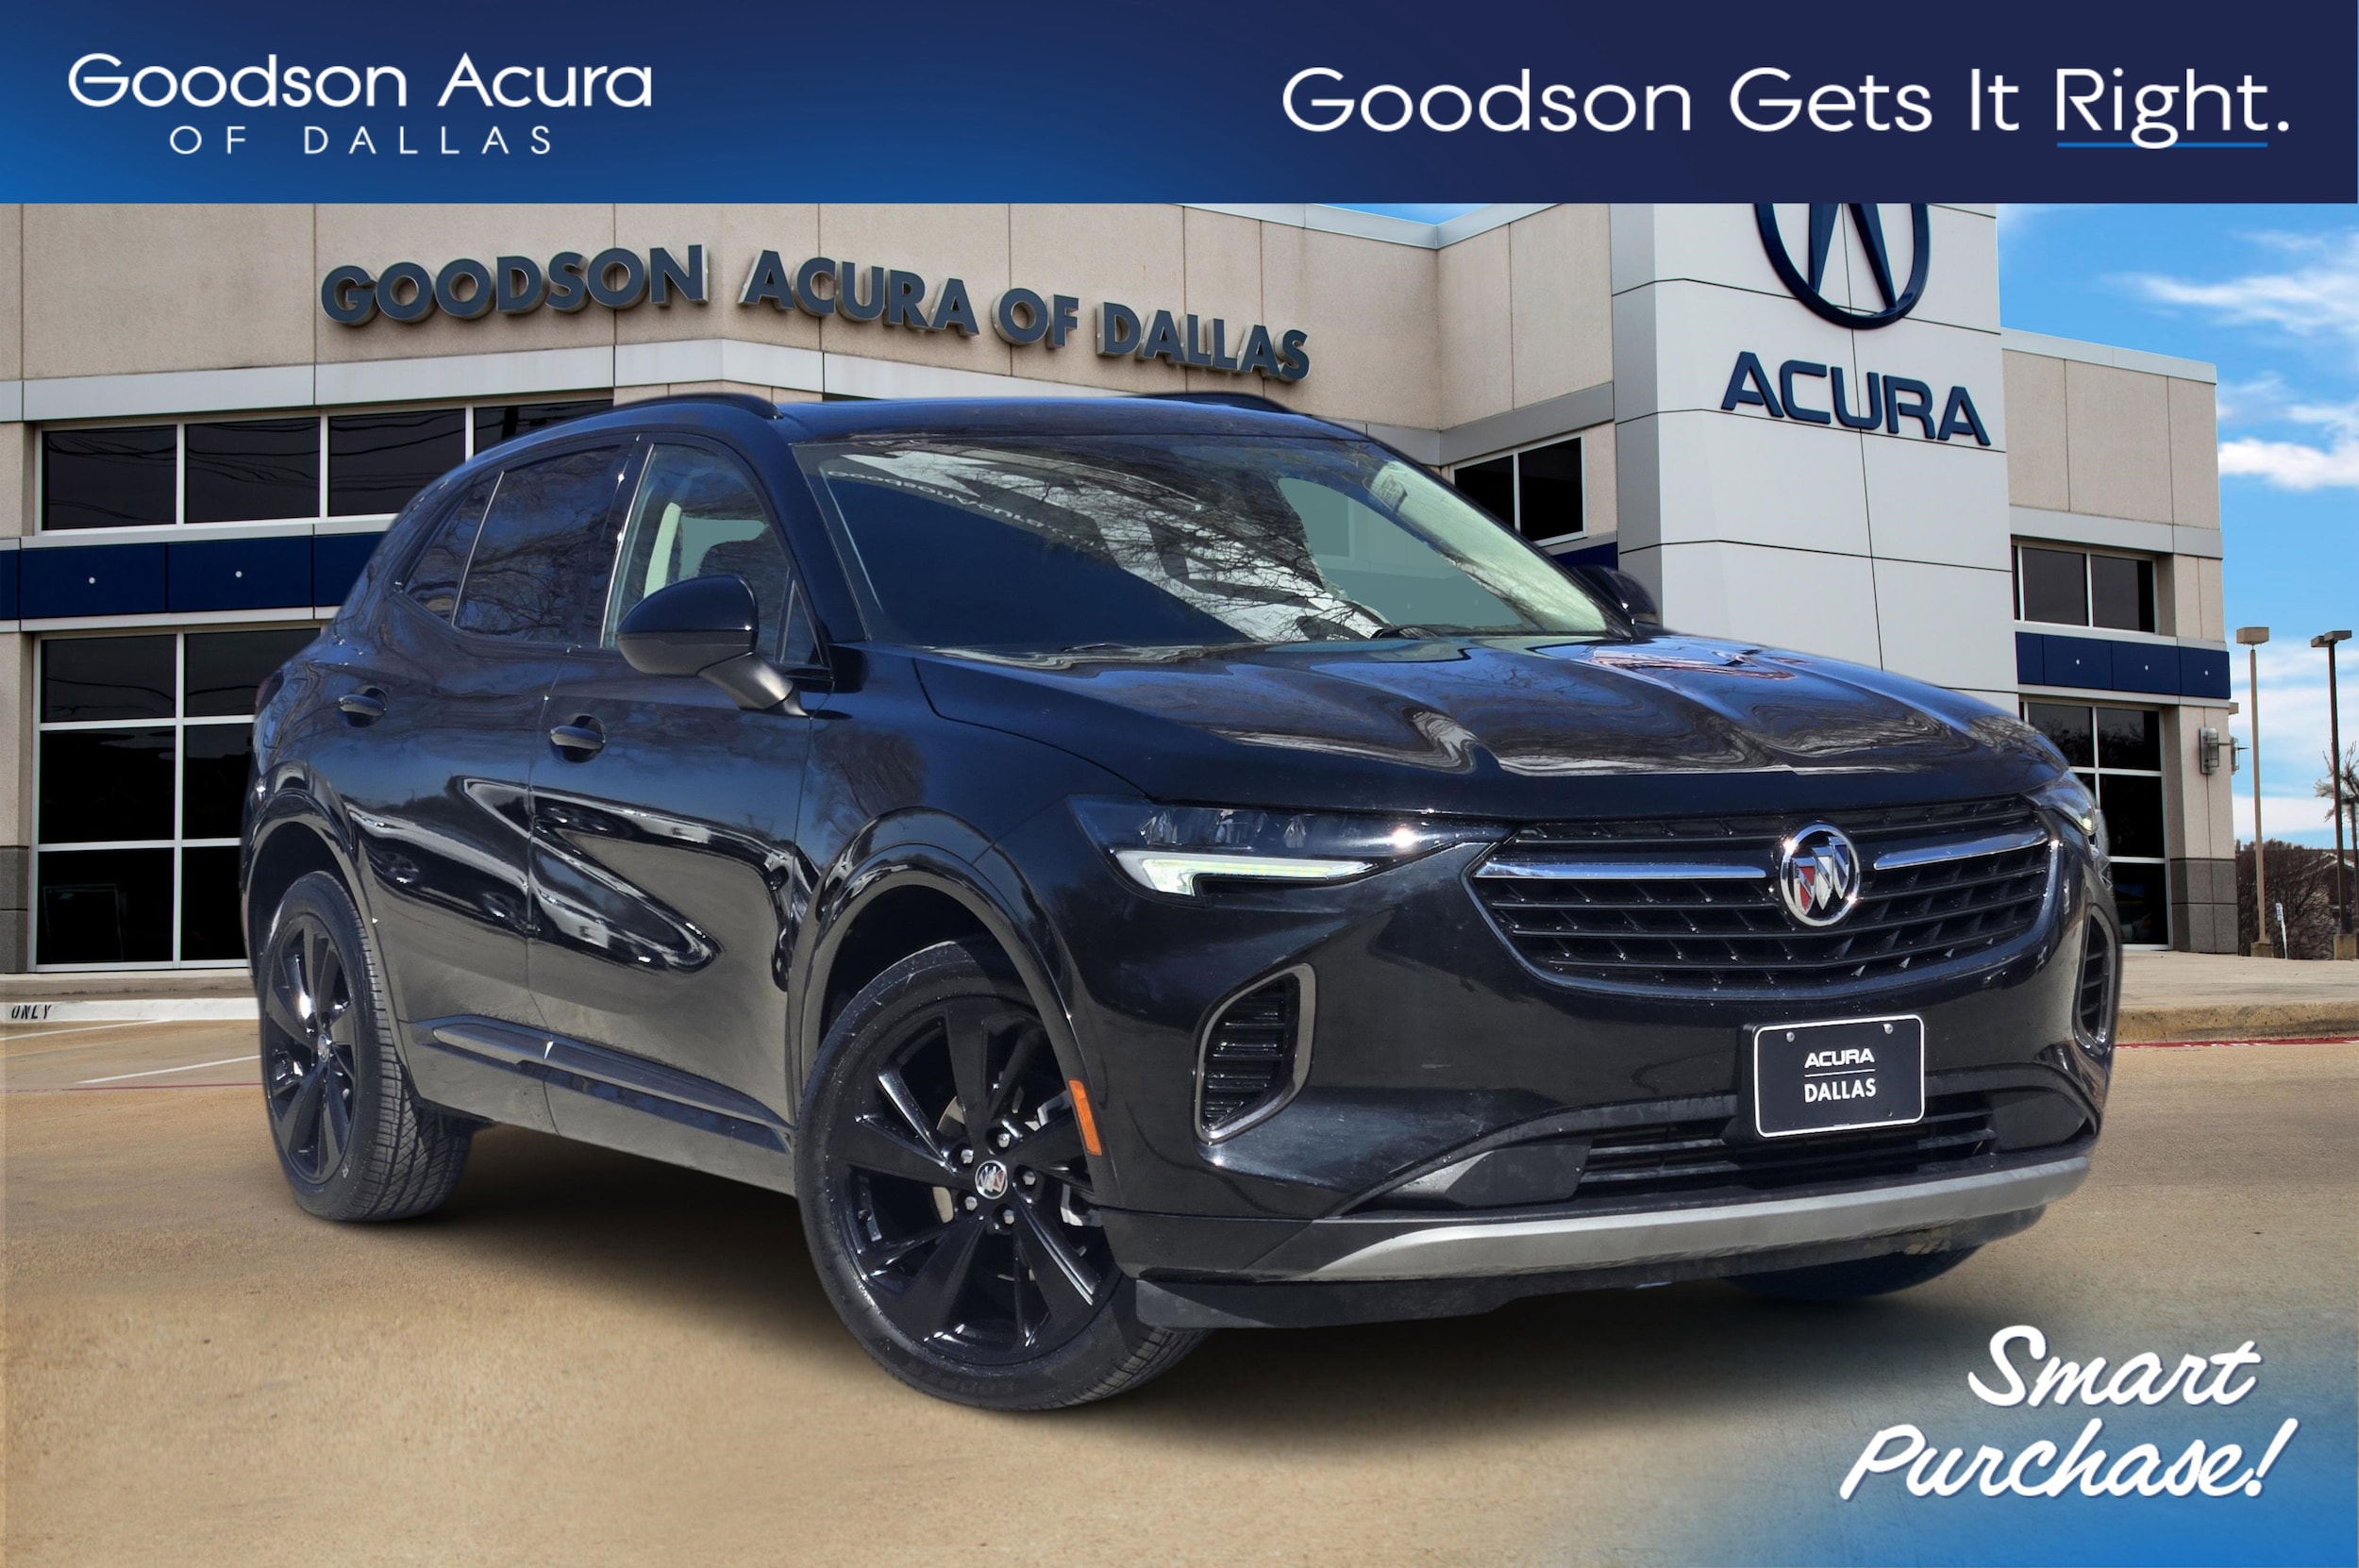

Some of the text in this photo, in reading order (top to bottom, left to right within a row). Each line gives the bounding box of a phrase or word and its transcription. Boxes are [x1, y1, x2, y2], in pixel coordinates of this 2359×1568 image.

[321, 244, 1311, 382] GOODSON ACURA OF DALLAS
[1721, 351, 1992, 446] ACURA
[11, 1005, 52, 1020] ONLY
[1803, 1047, 1875, 1069] ACURA
[1803, 1077, 1877, 1103] DALLAS
